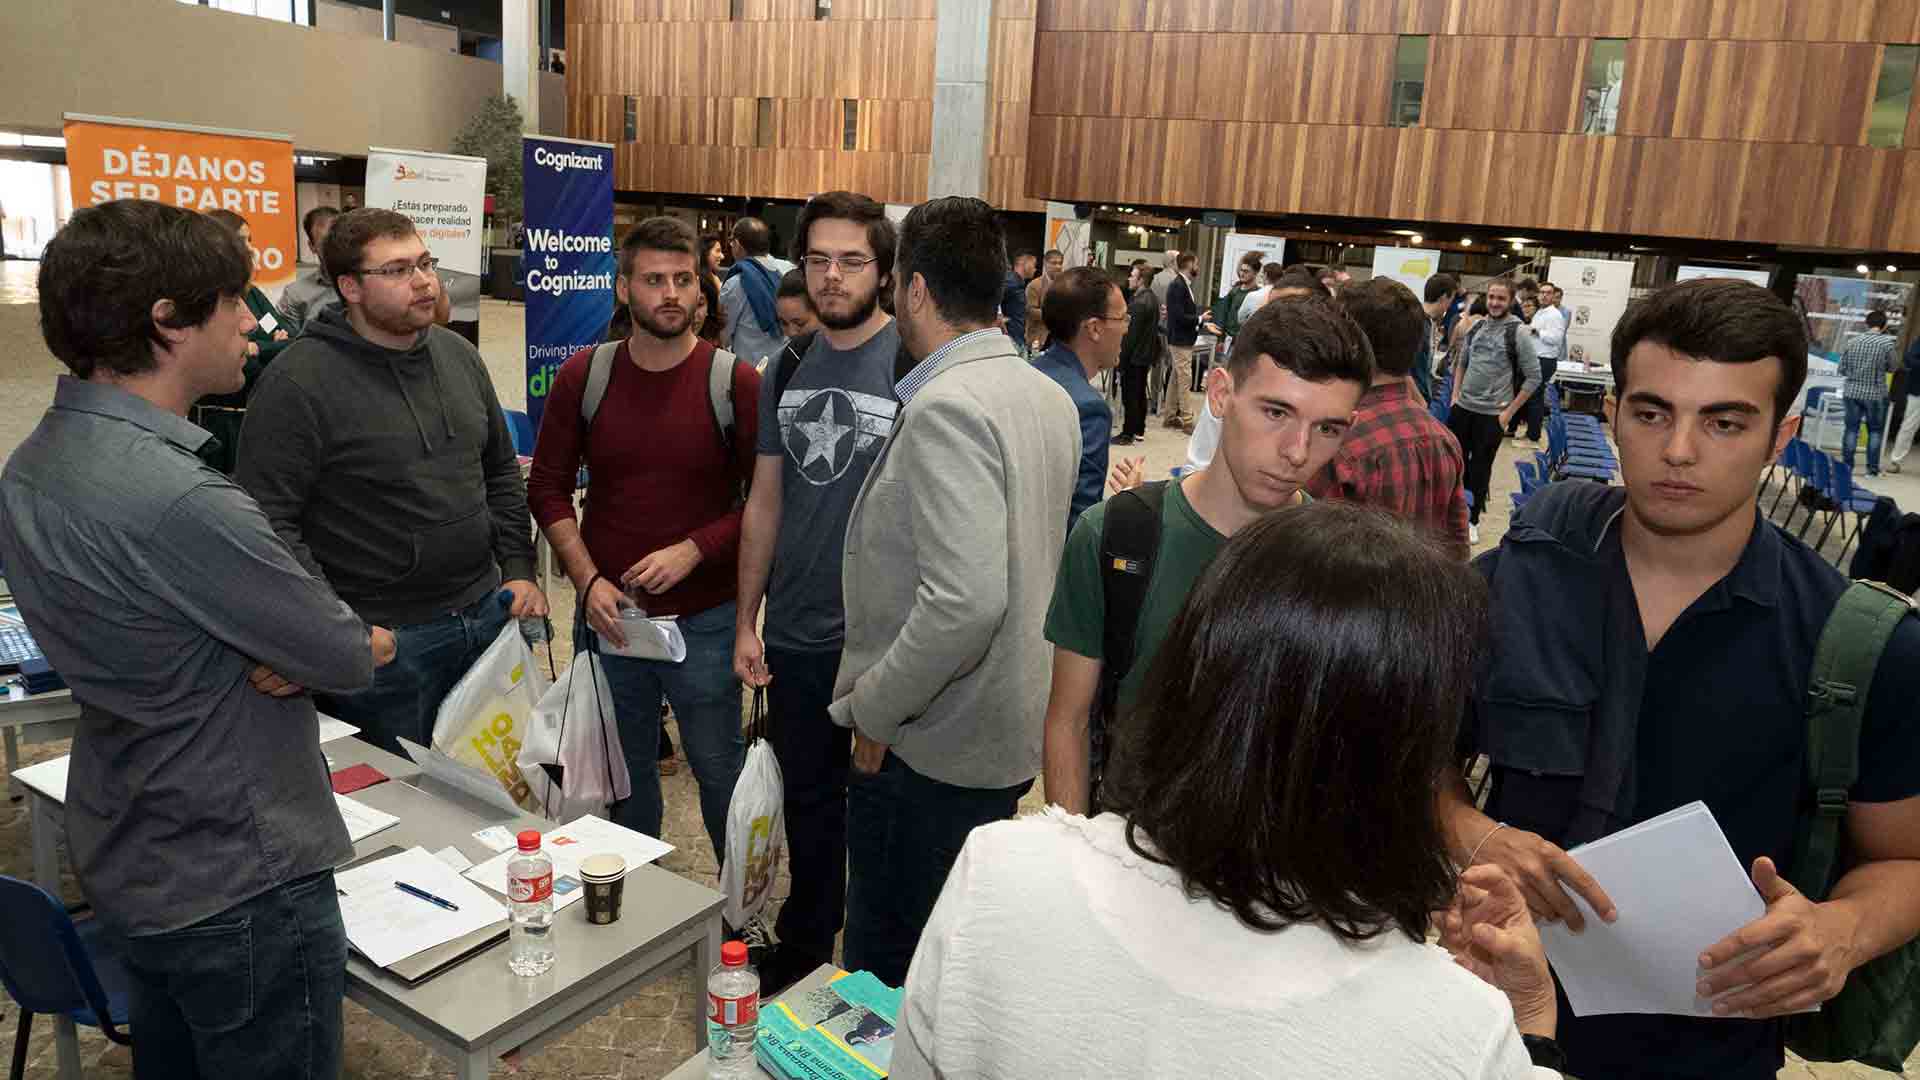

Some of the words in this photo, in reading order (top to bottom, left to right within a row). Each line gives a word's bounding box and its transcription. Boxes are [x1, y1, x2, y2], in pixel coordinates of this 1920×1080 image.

[103, 145, 265, 184] DÉJANOS
[534, 147, 604, 172] Cognizant
[174, 185, 281, 214] PARTE
[392, 200, 420, 210] ¿Estás
[423, 203, 468, 213] preparado
[437, 216, 471, 226] realidad
[526, 229, 612, 253] Welcome
[544, 254, 559, 270] to
[527, 270, 612, 296] Cognizant
[529, 345, 567, 359] Driving
[810, 1055, 848, 1080] ograma
